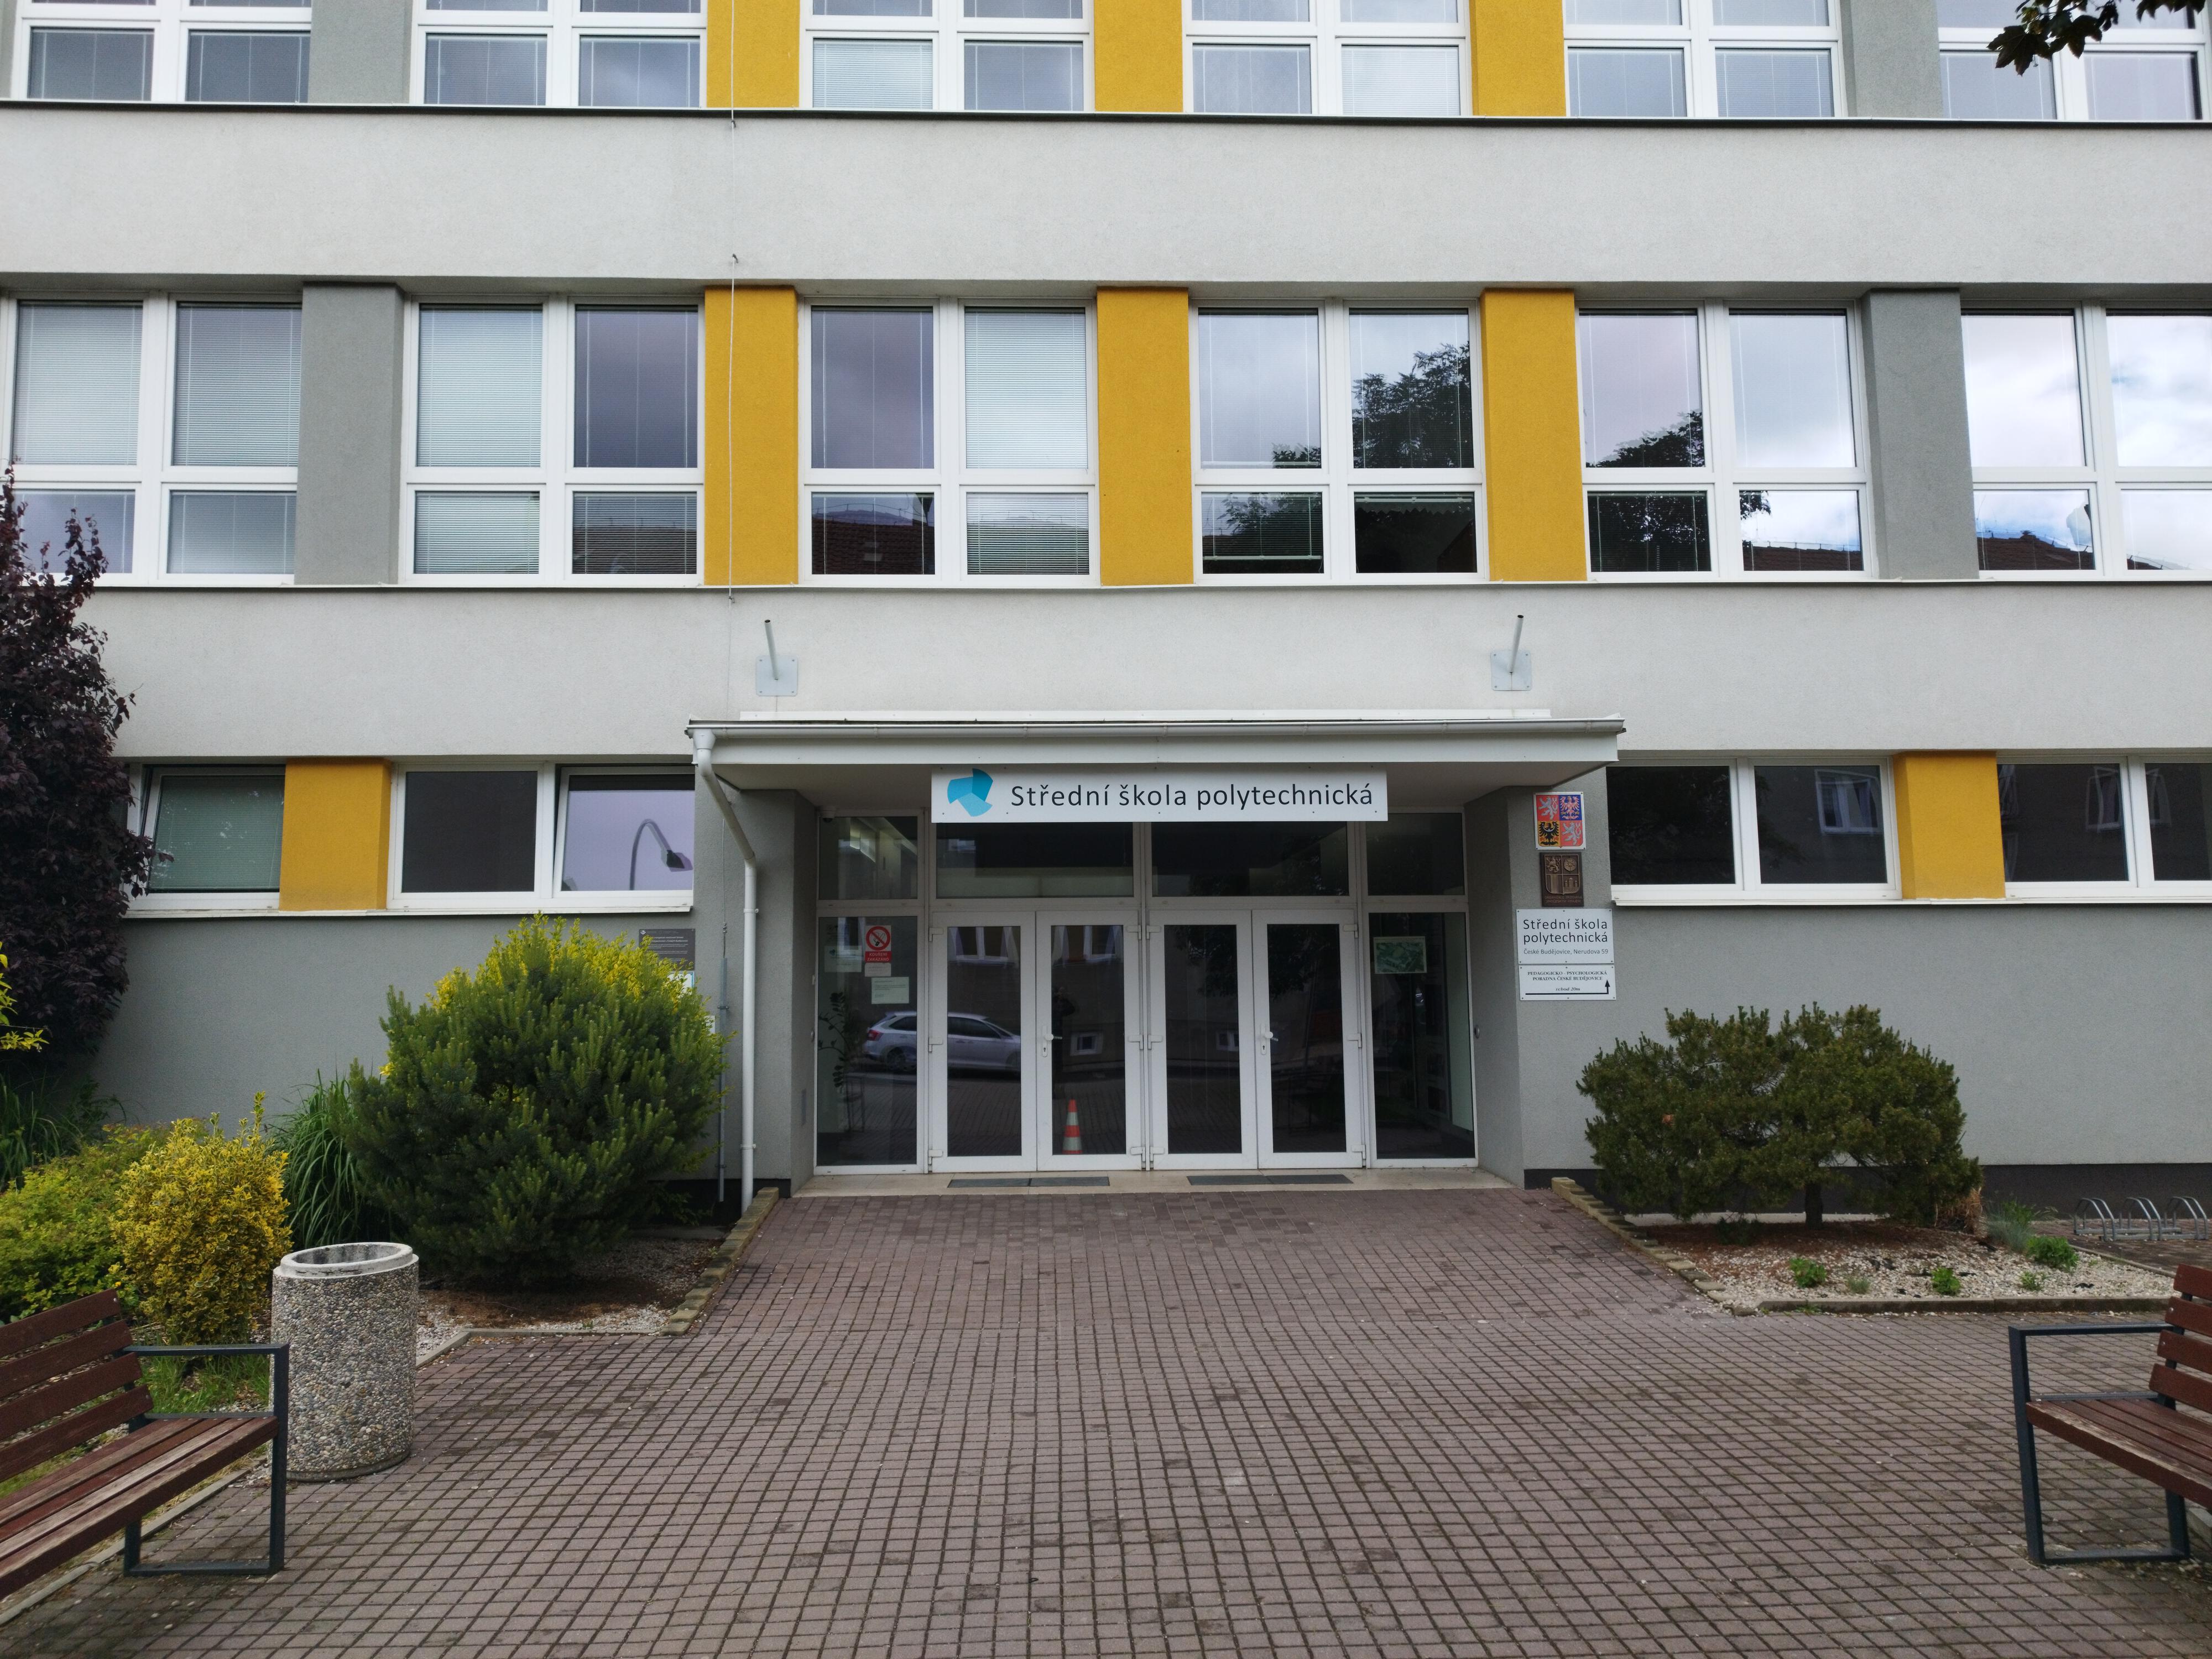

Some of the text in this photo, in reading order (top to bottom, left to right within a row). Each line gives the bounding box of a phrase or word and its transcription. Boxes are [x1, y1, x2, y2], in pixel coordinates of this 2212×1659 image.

[1011, 782, 1372, 811] Střední škola polytechnická
[1523, 918, 1608, 930] Střední škola
[1523, 931, 1608, 945] polytechnická
